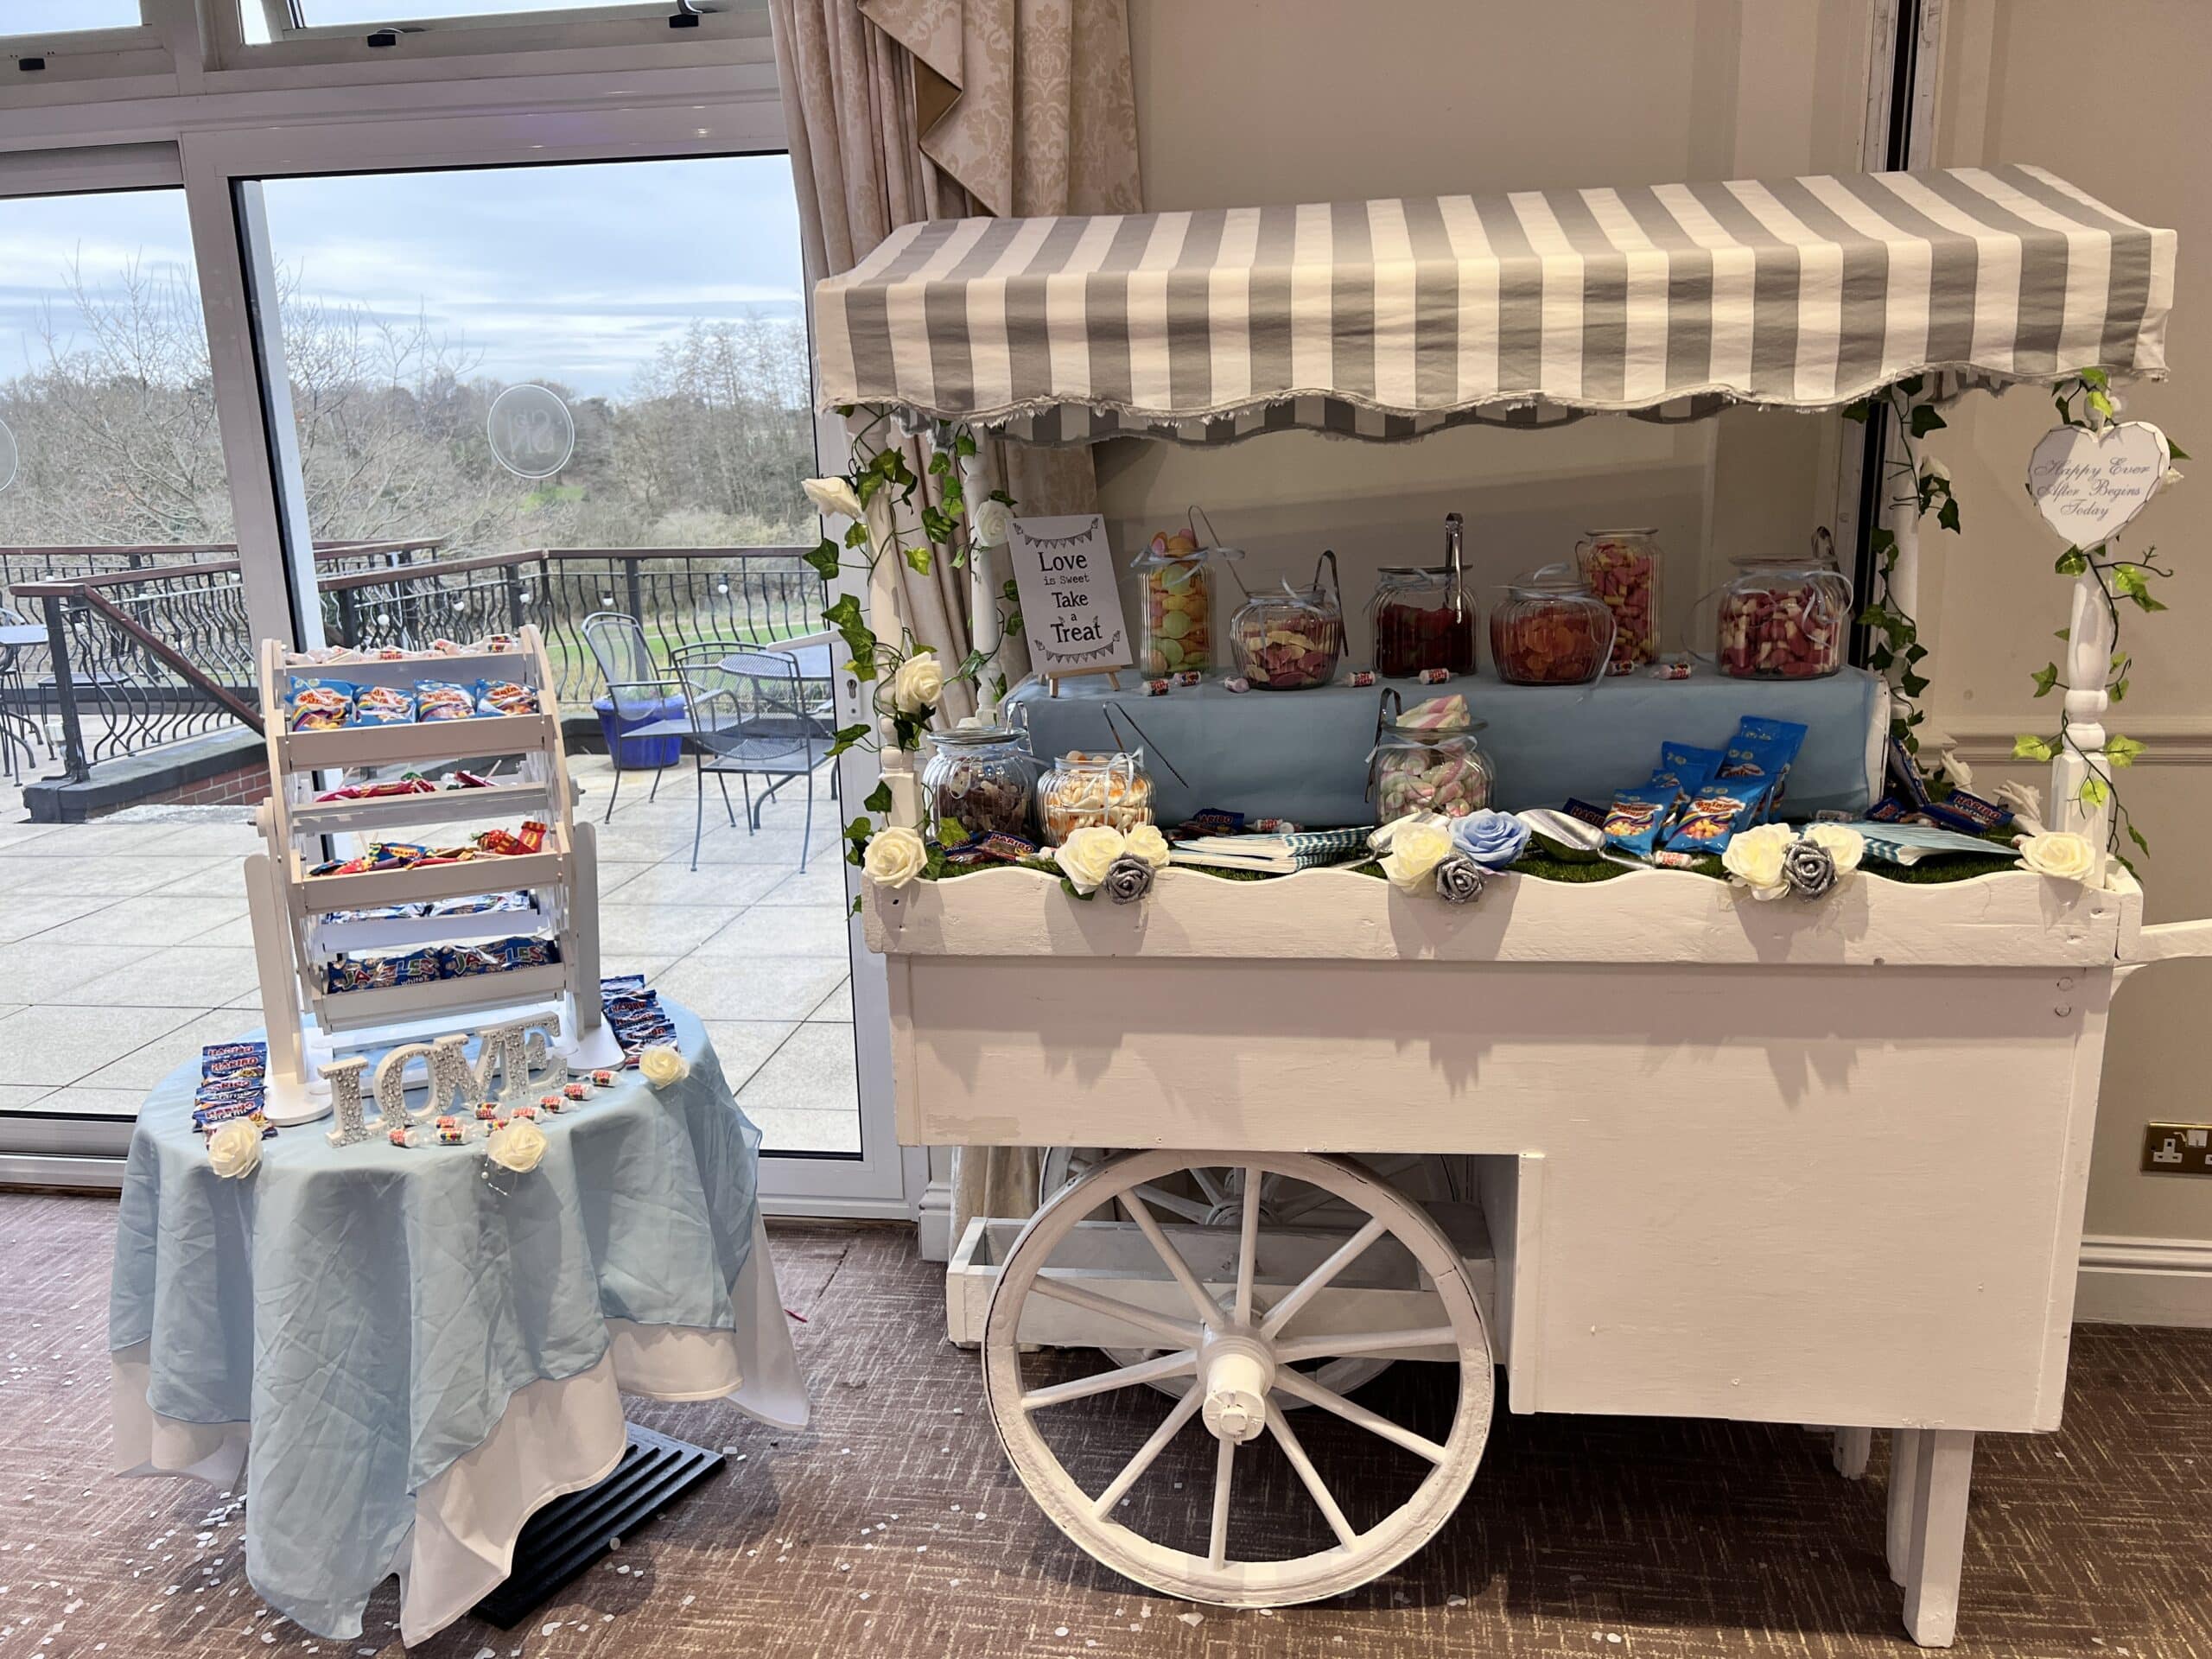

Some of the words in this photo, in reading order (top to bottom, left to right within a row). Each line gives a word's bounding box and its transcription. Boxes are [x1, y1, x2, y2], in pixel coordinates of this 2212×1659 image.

[2034, 460, 2101, 481] Happy
[2109, 457, 2151, 475] Ever
[2037, 483, 2081, 502] After
[2088, 479, 2141, 503] Begins
[2060, 499, 2110, 522] Today
[1038, 551, 1089, 572] Love
[1044, 576, 1057, 586] is
[1059, 574, 1090, 585] Sweet
[1052, 591, 1090, 608] Take
[1050, 622, 1103, 643] Treat
[1954, 795, 2003, 820] HARIBO
[989, 833, 1034, 853] HARIBO
[211, 1056, 259, 1072] HARIBO
[316, 1011, 568, 1148] LOVE
